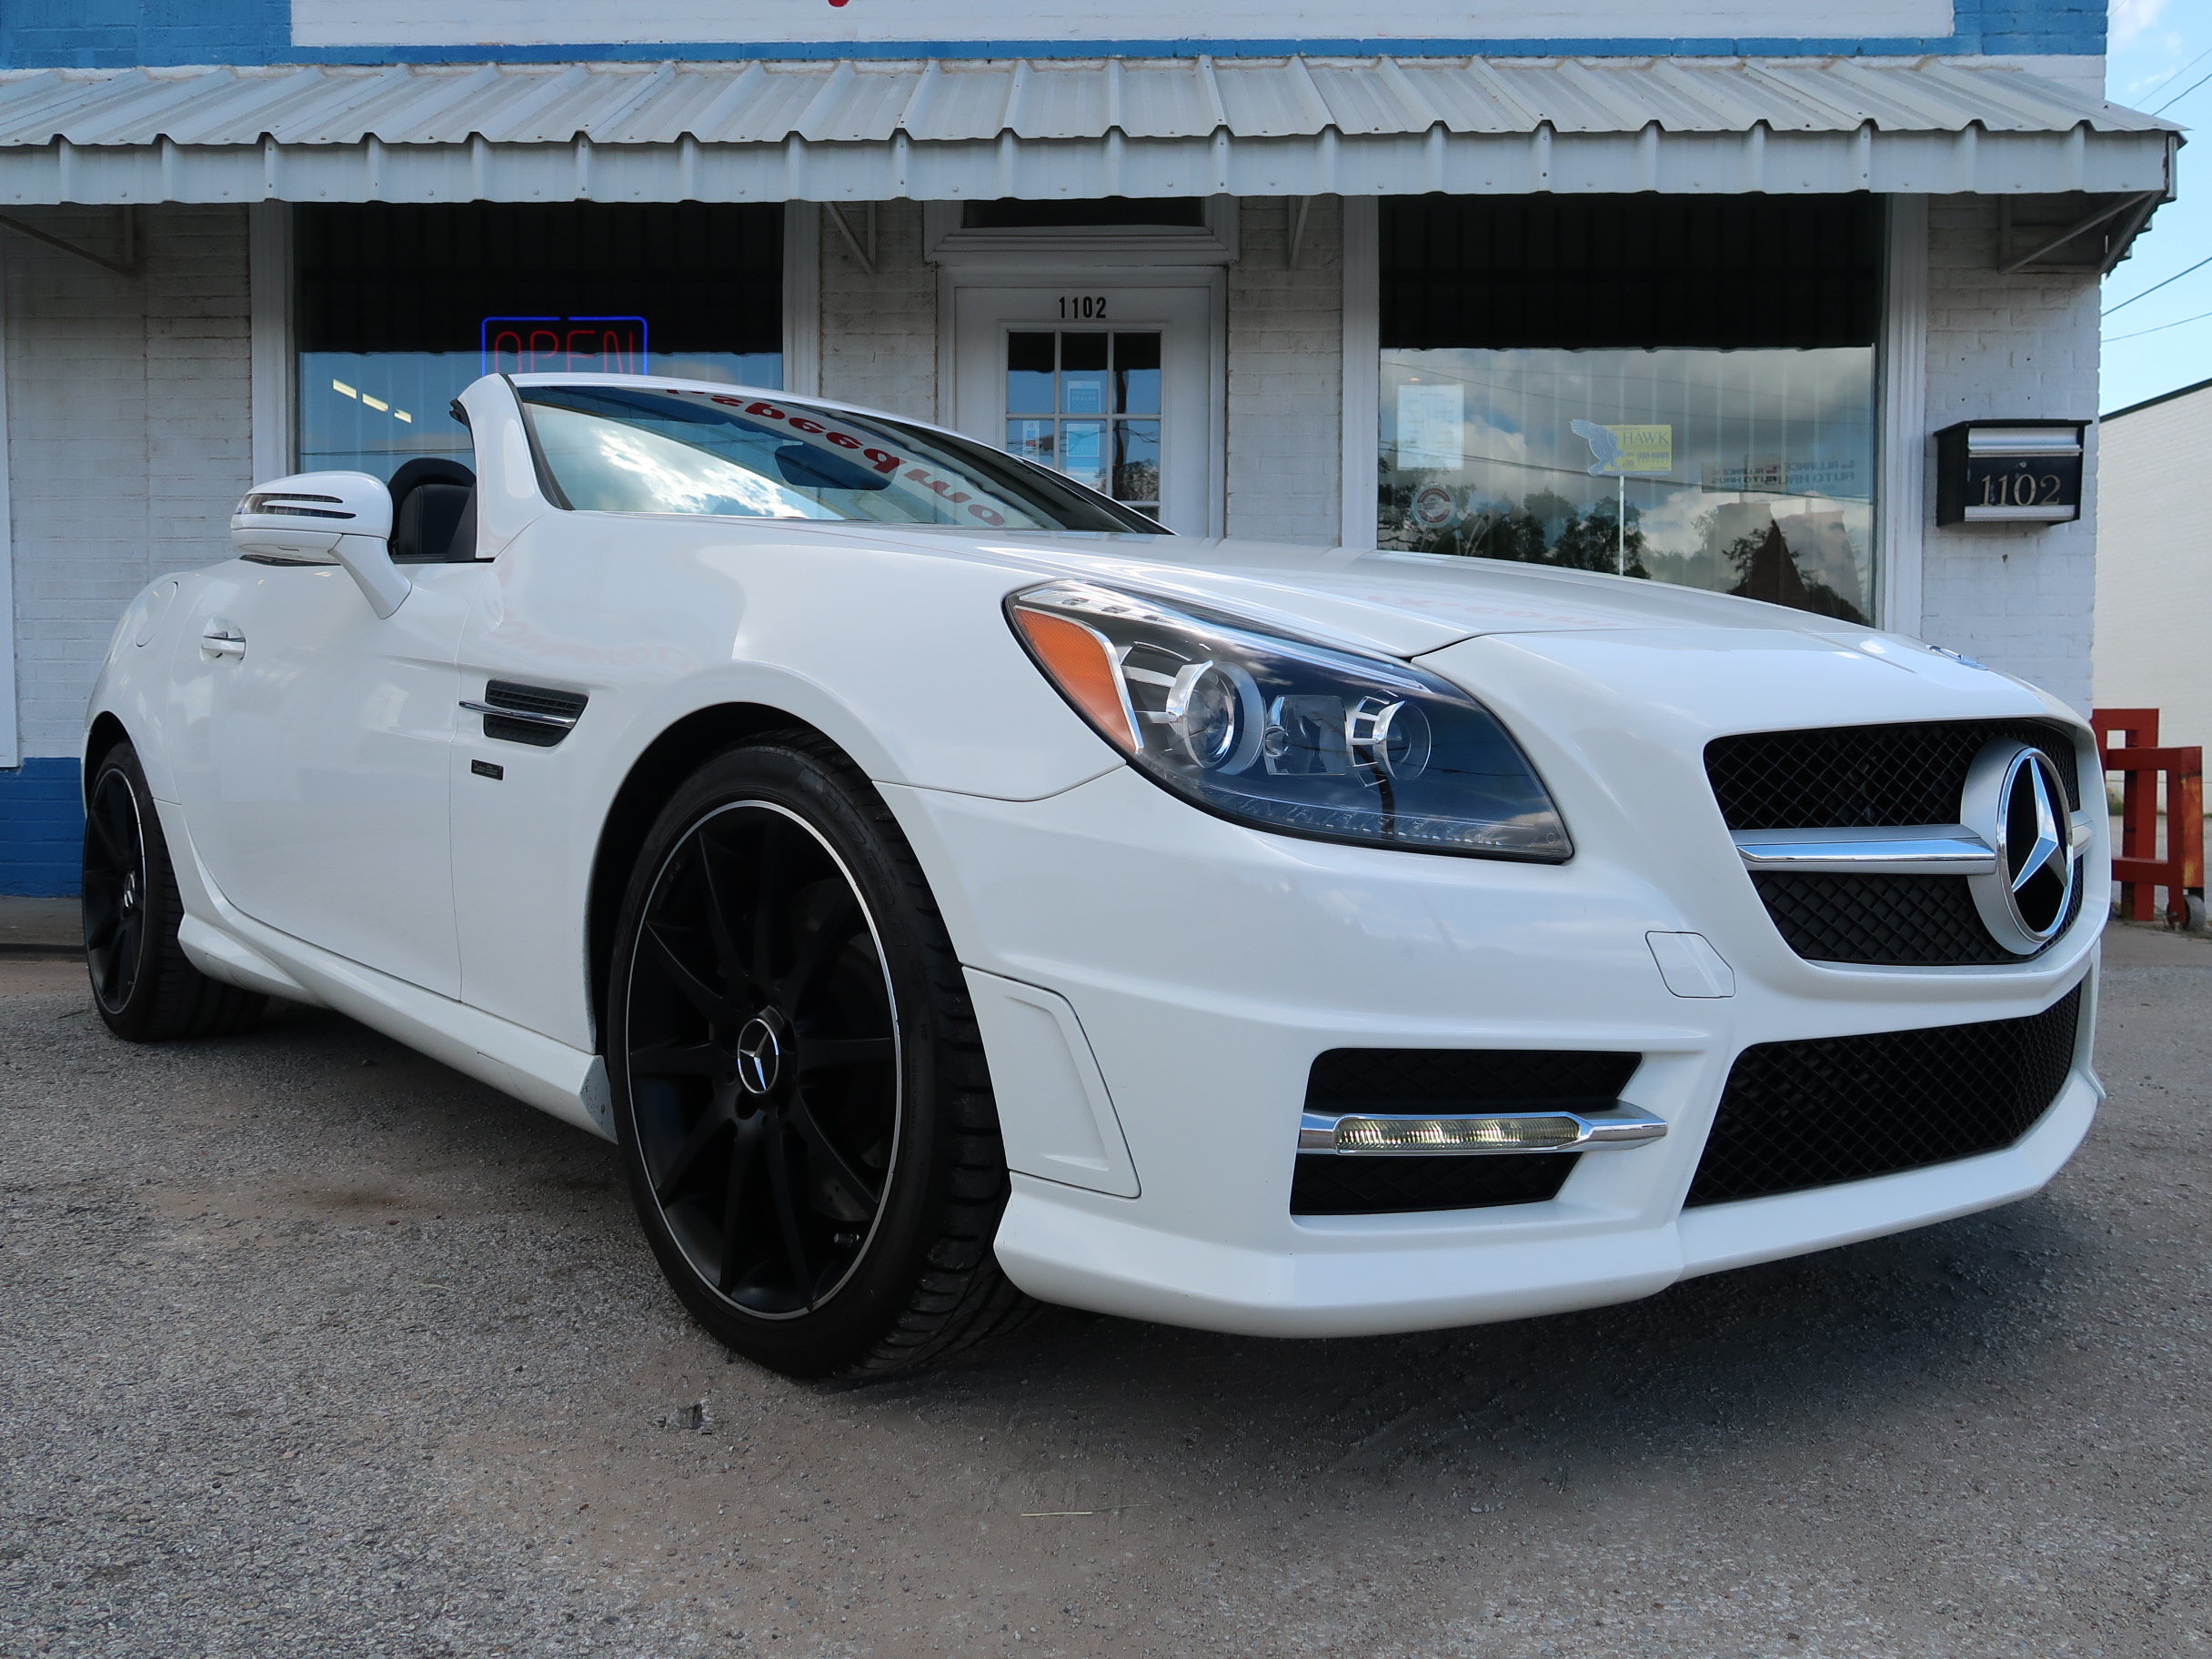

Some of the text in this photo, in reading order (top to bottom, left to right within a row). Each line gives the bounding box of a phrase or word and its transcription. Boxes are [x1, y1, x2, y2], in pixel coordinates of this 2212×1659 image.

[1059, 296, 1107, 319] 1102
[494, 330, 634, 374] OPEN
[1623, 431, 1670, 445] HAWK
[1979, 473, 2062, 507] 1102
